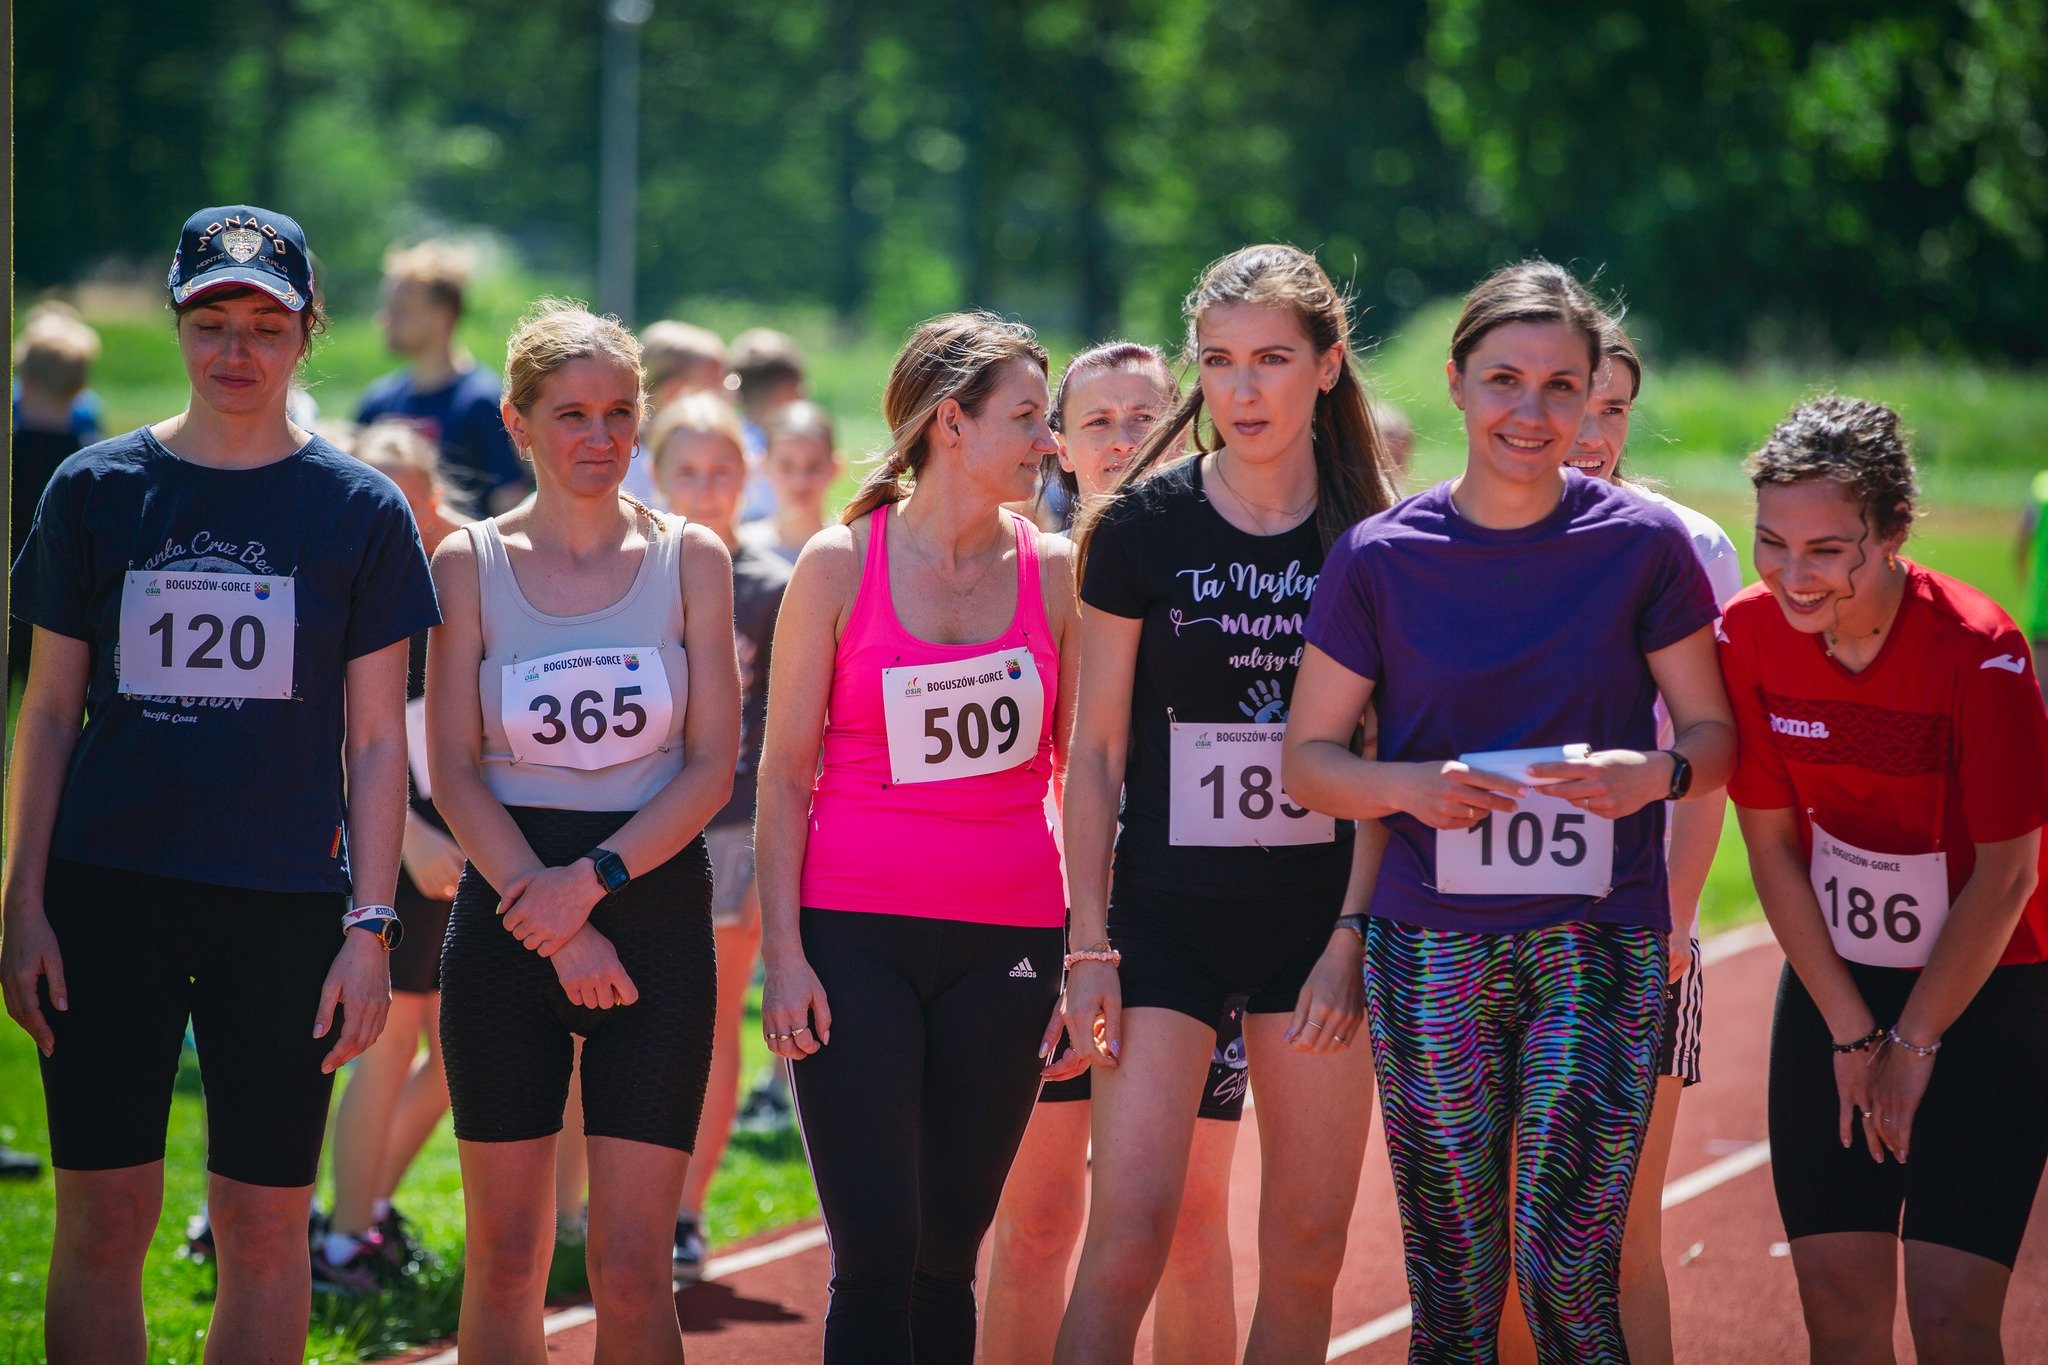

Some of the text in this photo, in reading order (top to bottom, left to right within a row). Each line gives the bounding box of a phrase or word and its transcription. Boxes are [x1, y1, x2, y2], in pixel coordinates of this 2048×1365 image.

[196, 252, 288, 273] MONTE CARLO
[140, 530, 279, 576] anta Cruz Bea
[165, 578, 251, 593] BOGUSZÓW-GORCE
[1176, 563, 1226, 602] Ta
[149, 612, 266, 670] 120
[543, 655, 622, 673] BOGUSZÓW-GORCE
[1228, 646, 1288, 671] należy
[927, 670, 1004, 692] BOGUSZÓW-GORCE
[171, 713, 199, 723] Coast
[528, 685, 647, 745] 365
[924, 695, 1020, 764] 509
[1216, 731, 1286, 742] BOGUSZÓW-GO
[1468, 812, 1588, 867] 105
[1831, 845, 1901, 872] BOGUSZÓW-GORCE
[1824, 875, 1922, 943] 186
[1009, 969, 1037, 978] adidas
